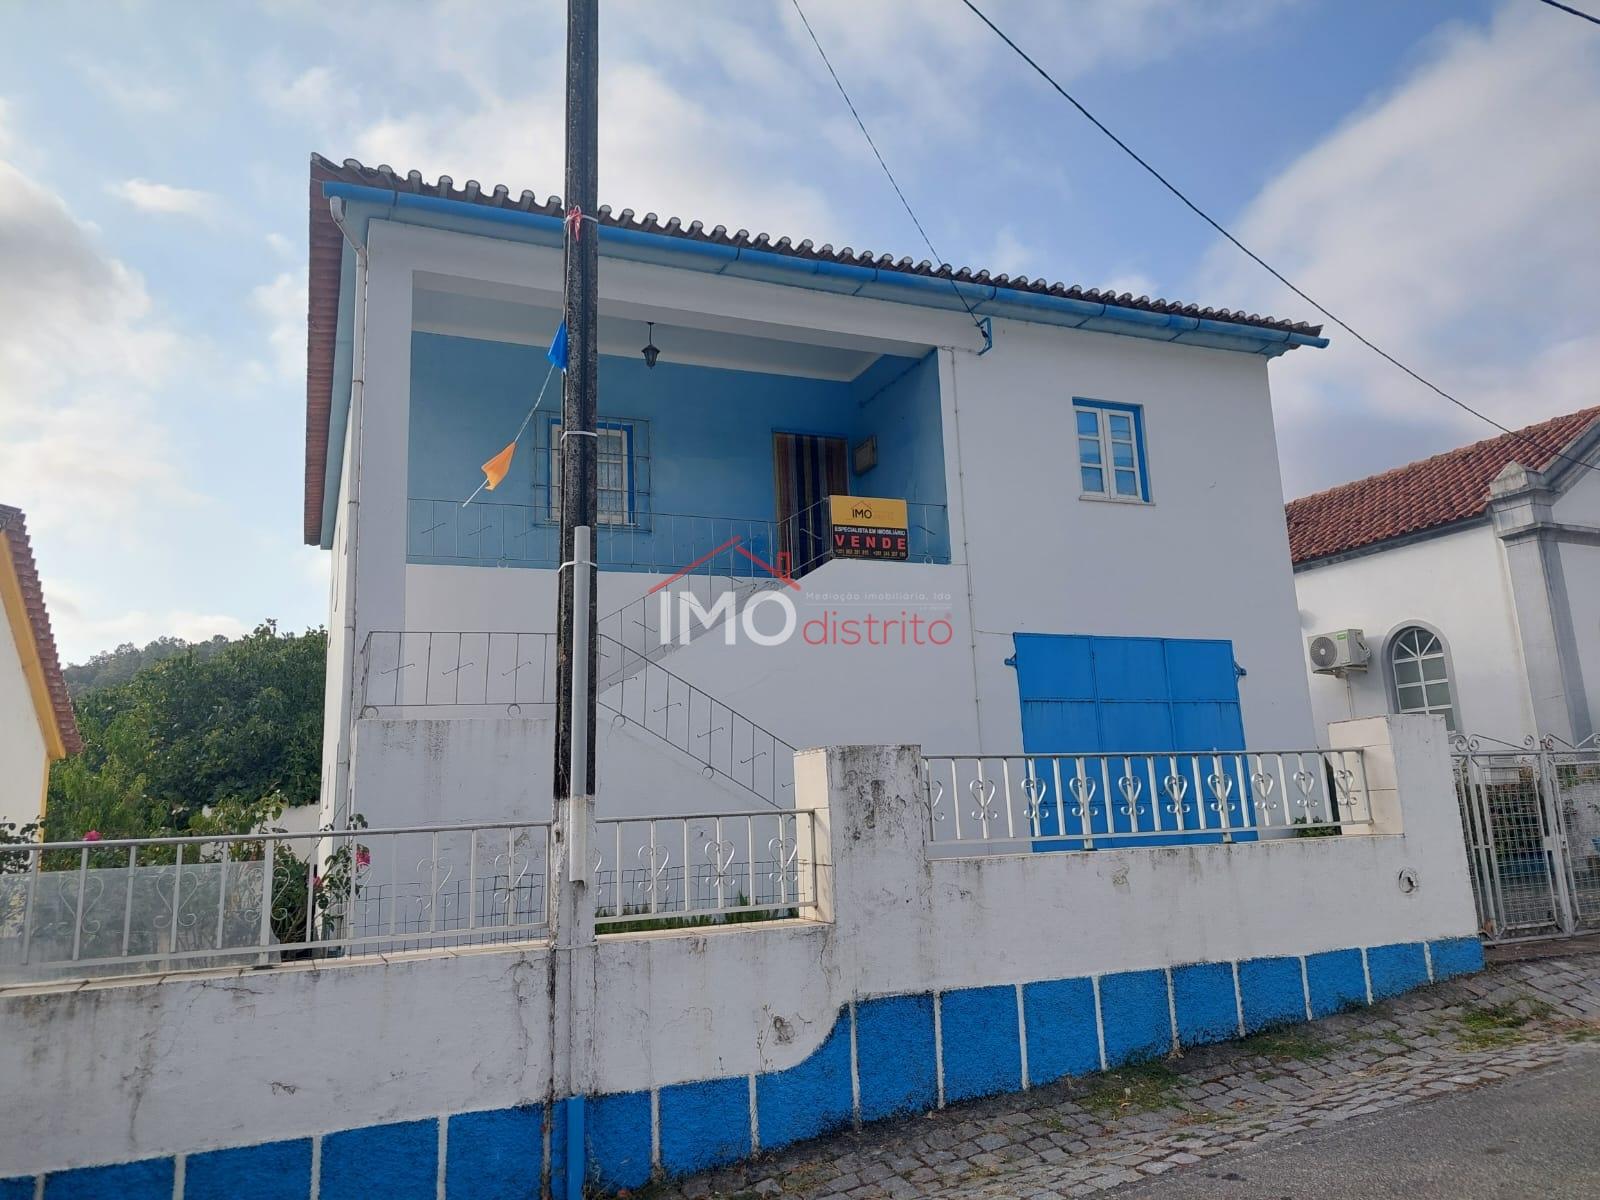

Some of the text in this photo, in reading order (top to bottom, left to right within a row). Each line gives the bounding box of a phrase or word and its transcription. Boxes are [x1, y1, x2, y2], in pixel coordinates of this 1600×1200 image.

[852, 509, 872, 519] IMO
[834, 526, 868, 534] ESPECIALISTA
[834, 534, 906, 550] VENDE
